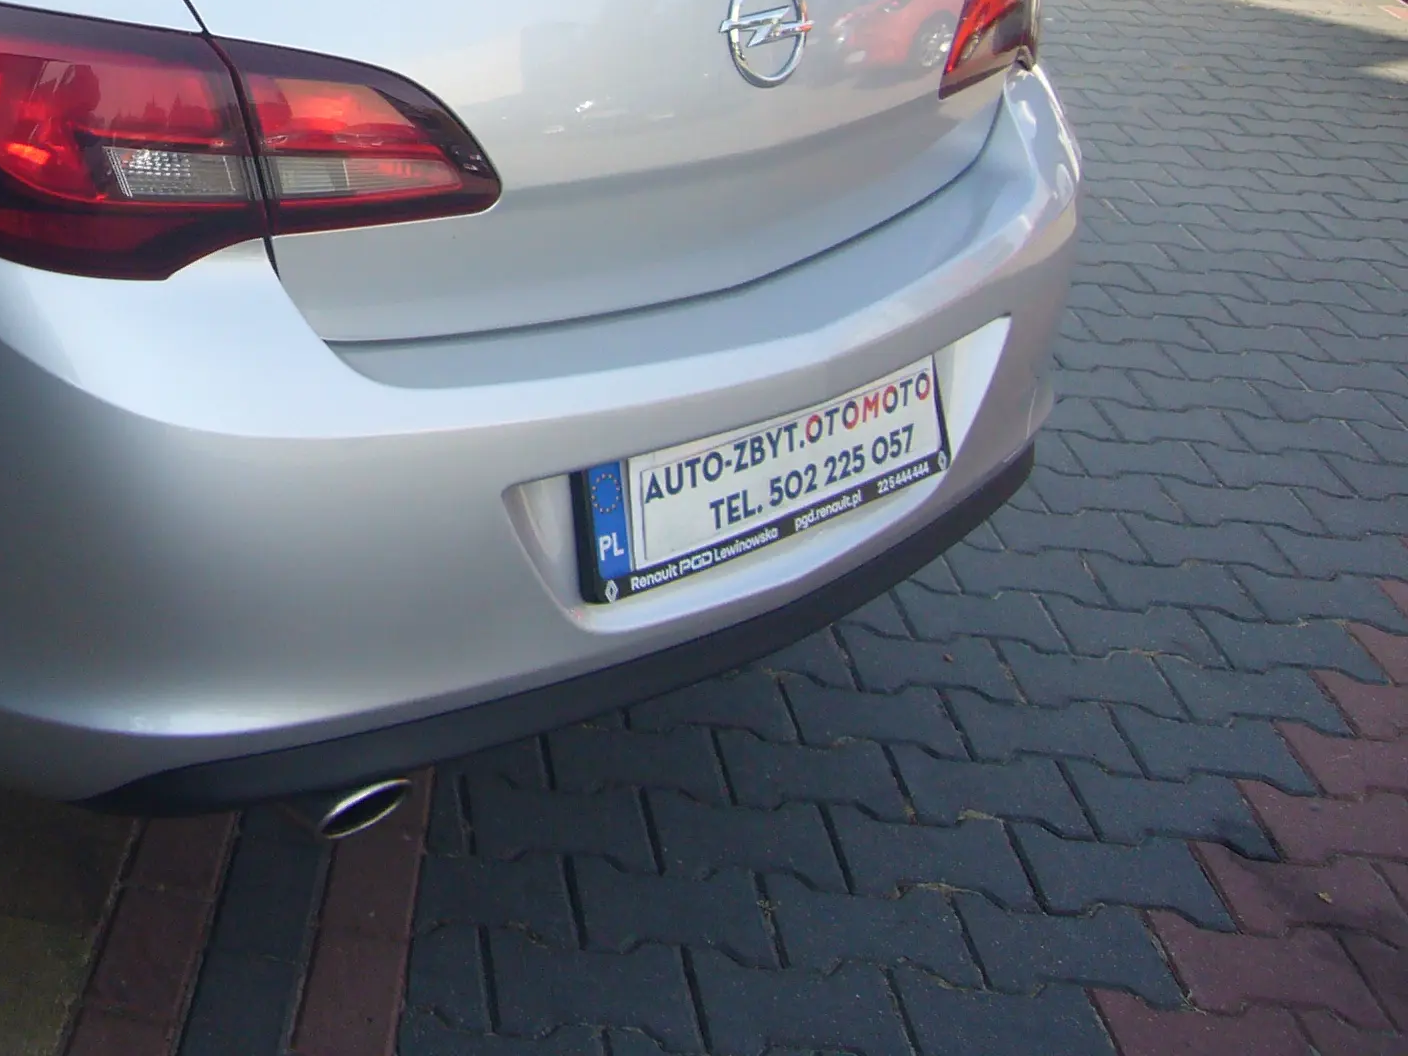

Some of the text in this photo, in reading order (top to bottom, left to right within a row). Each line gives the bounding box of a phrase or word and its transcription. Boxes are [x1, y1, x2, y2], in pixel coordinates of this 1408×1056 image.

[644, 372, 932, 504] AUTO-ZBYT.OTOMOTO
[709, 423, 915, 531] TEL. 502 225 057
[598, 531, 625, 562] PL
[630, 563, 679, 592] Renault
[679, 551, 713, 576] PGD
[713, 526, 779, 562] Lewinowska
[794, 489, 863, 532] pgd.renault.pl
